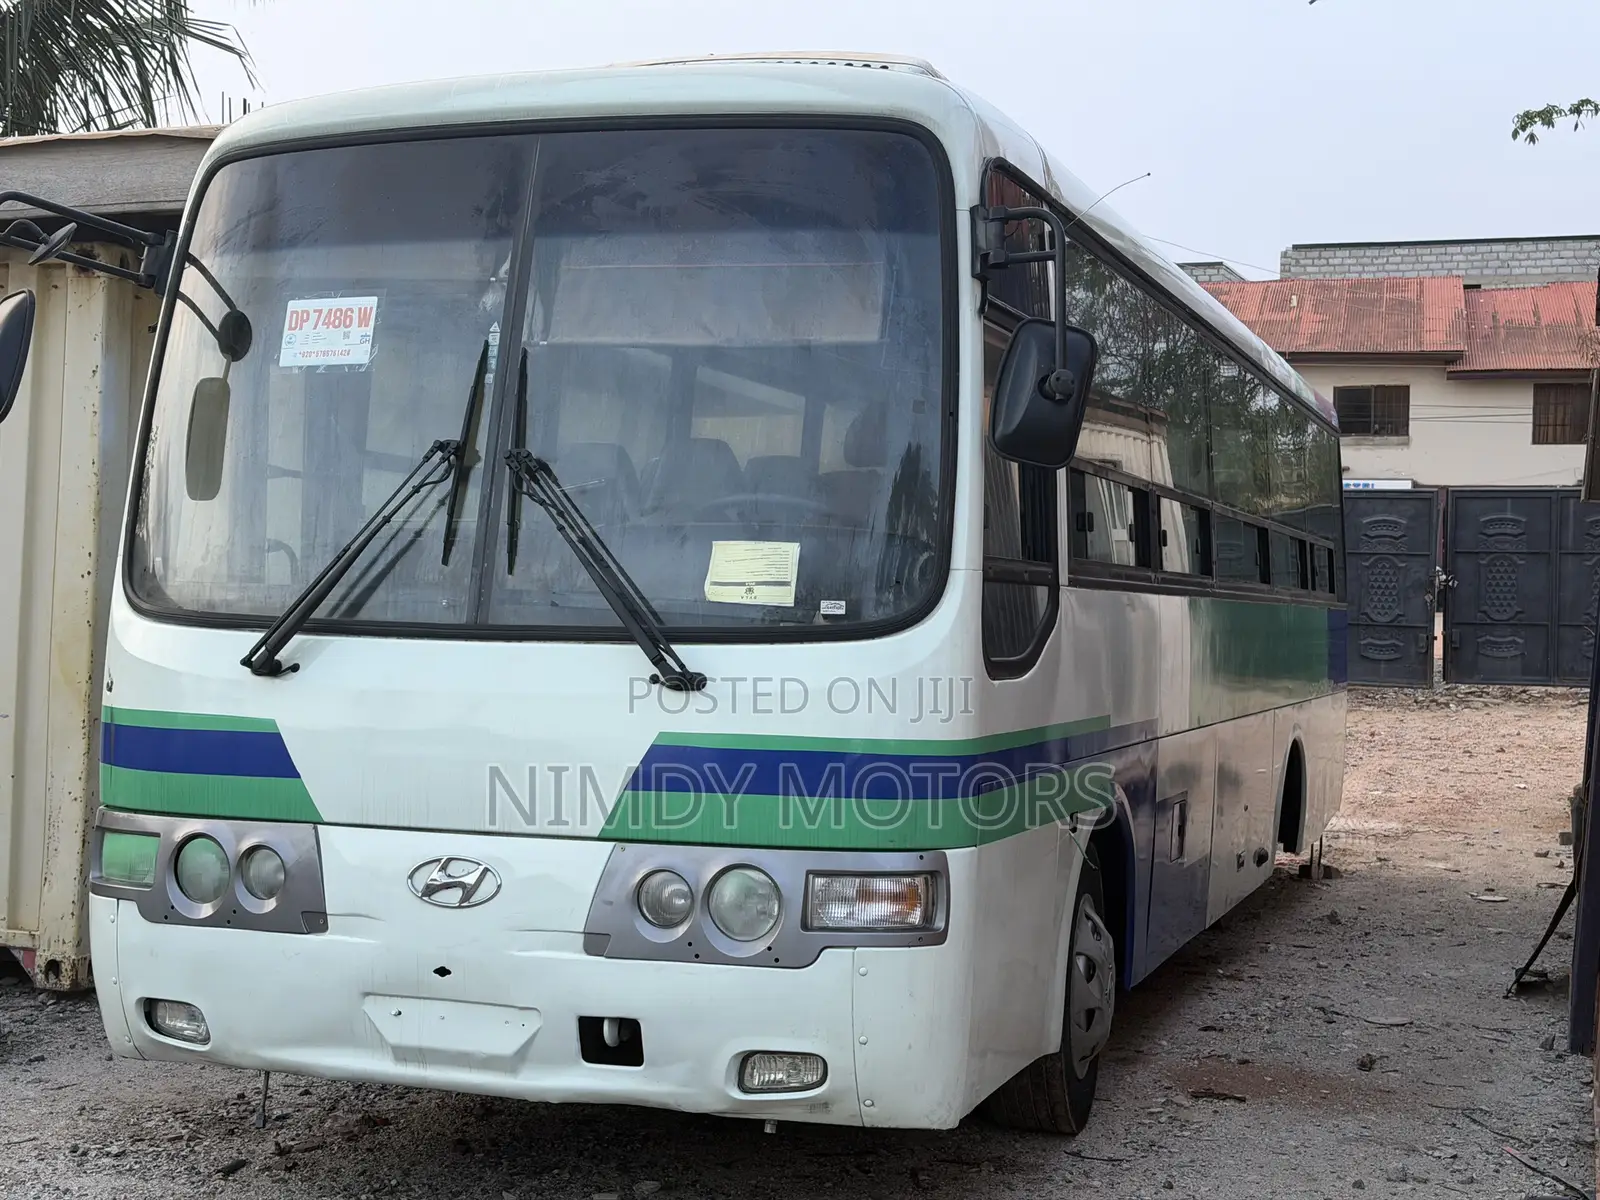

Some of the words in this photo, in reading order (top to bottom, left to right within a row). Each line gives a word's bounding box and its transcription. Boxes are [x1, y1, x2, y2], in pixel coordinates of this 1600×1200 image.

[288, 309, 310, 331] DP
[313, 307, 354, 330] 7486
[357, 306, 373, 328] W
